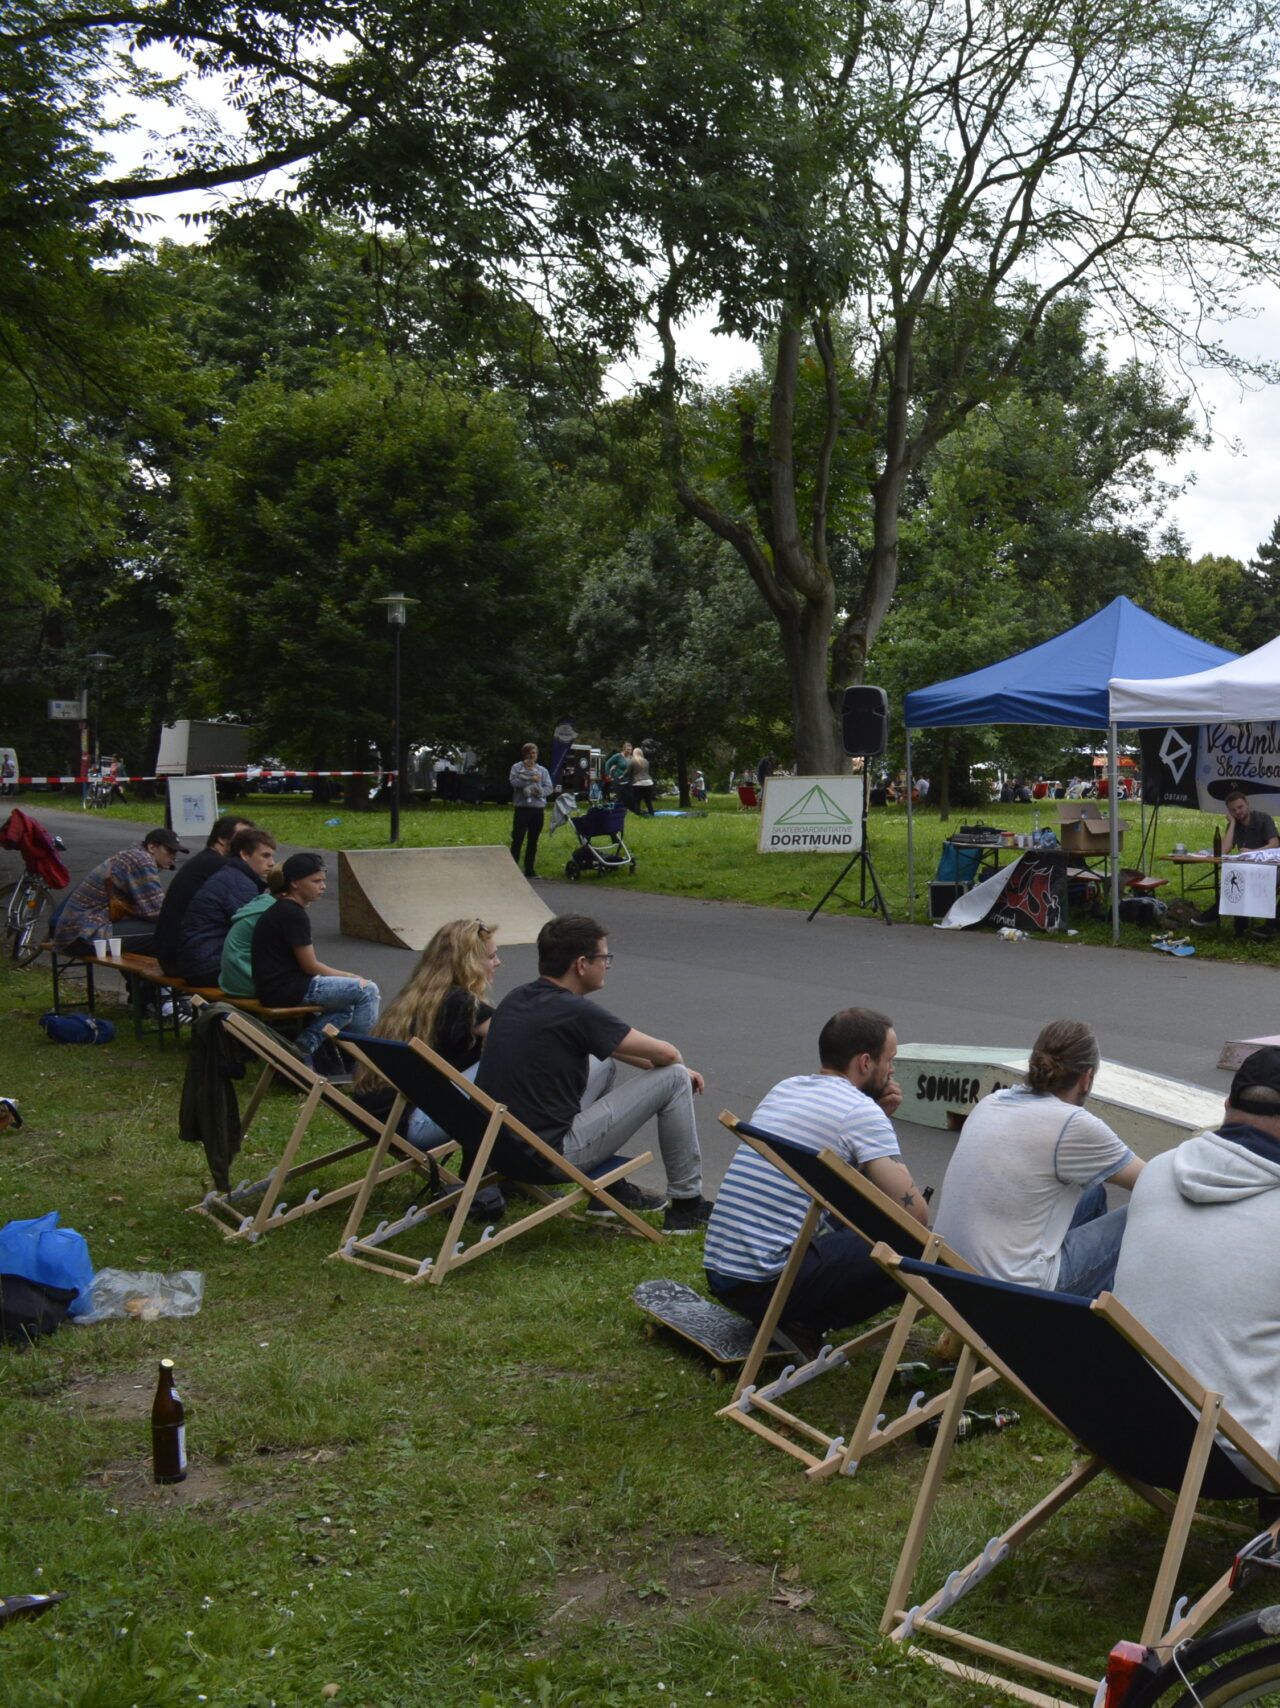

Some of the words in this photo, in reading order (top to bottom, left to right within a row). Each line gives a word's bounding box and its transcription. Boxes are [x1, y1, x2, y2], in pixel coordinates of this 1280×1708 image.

[771, 826, 853, 834] SKATEBOARDINITIATIVE
[770, 834, 852, 846] DORTMUND
[916, 1073, 981, 1104] SOMMER
